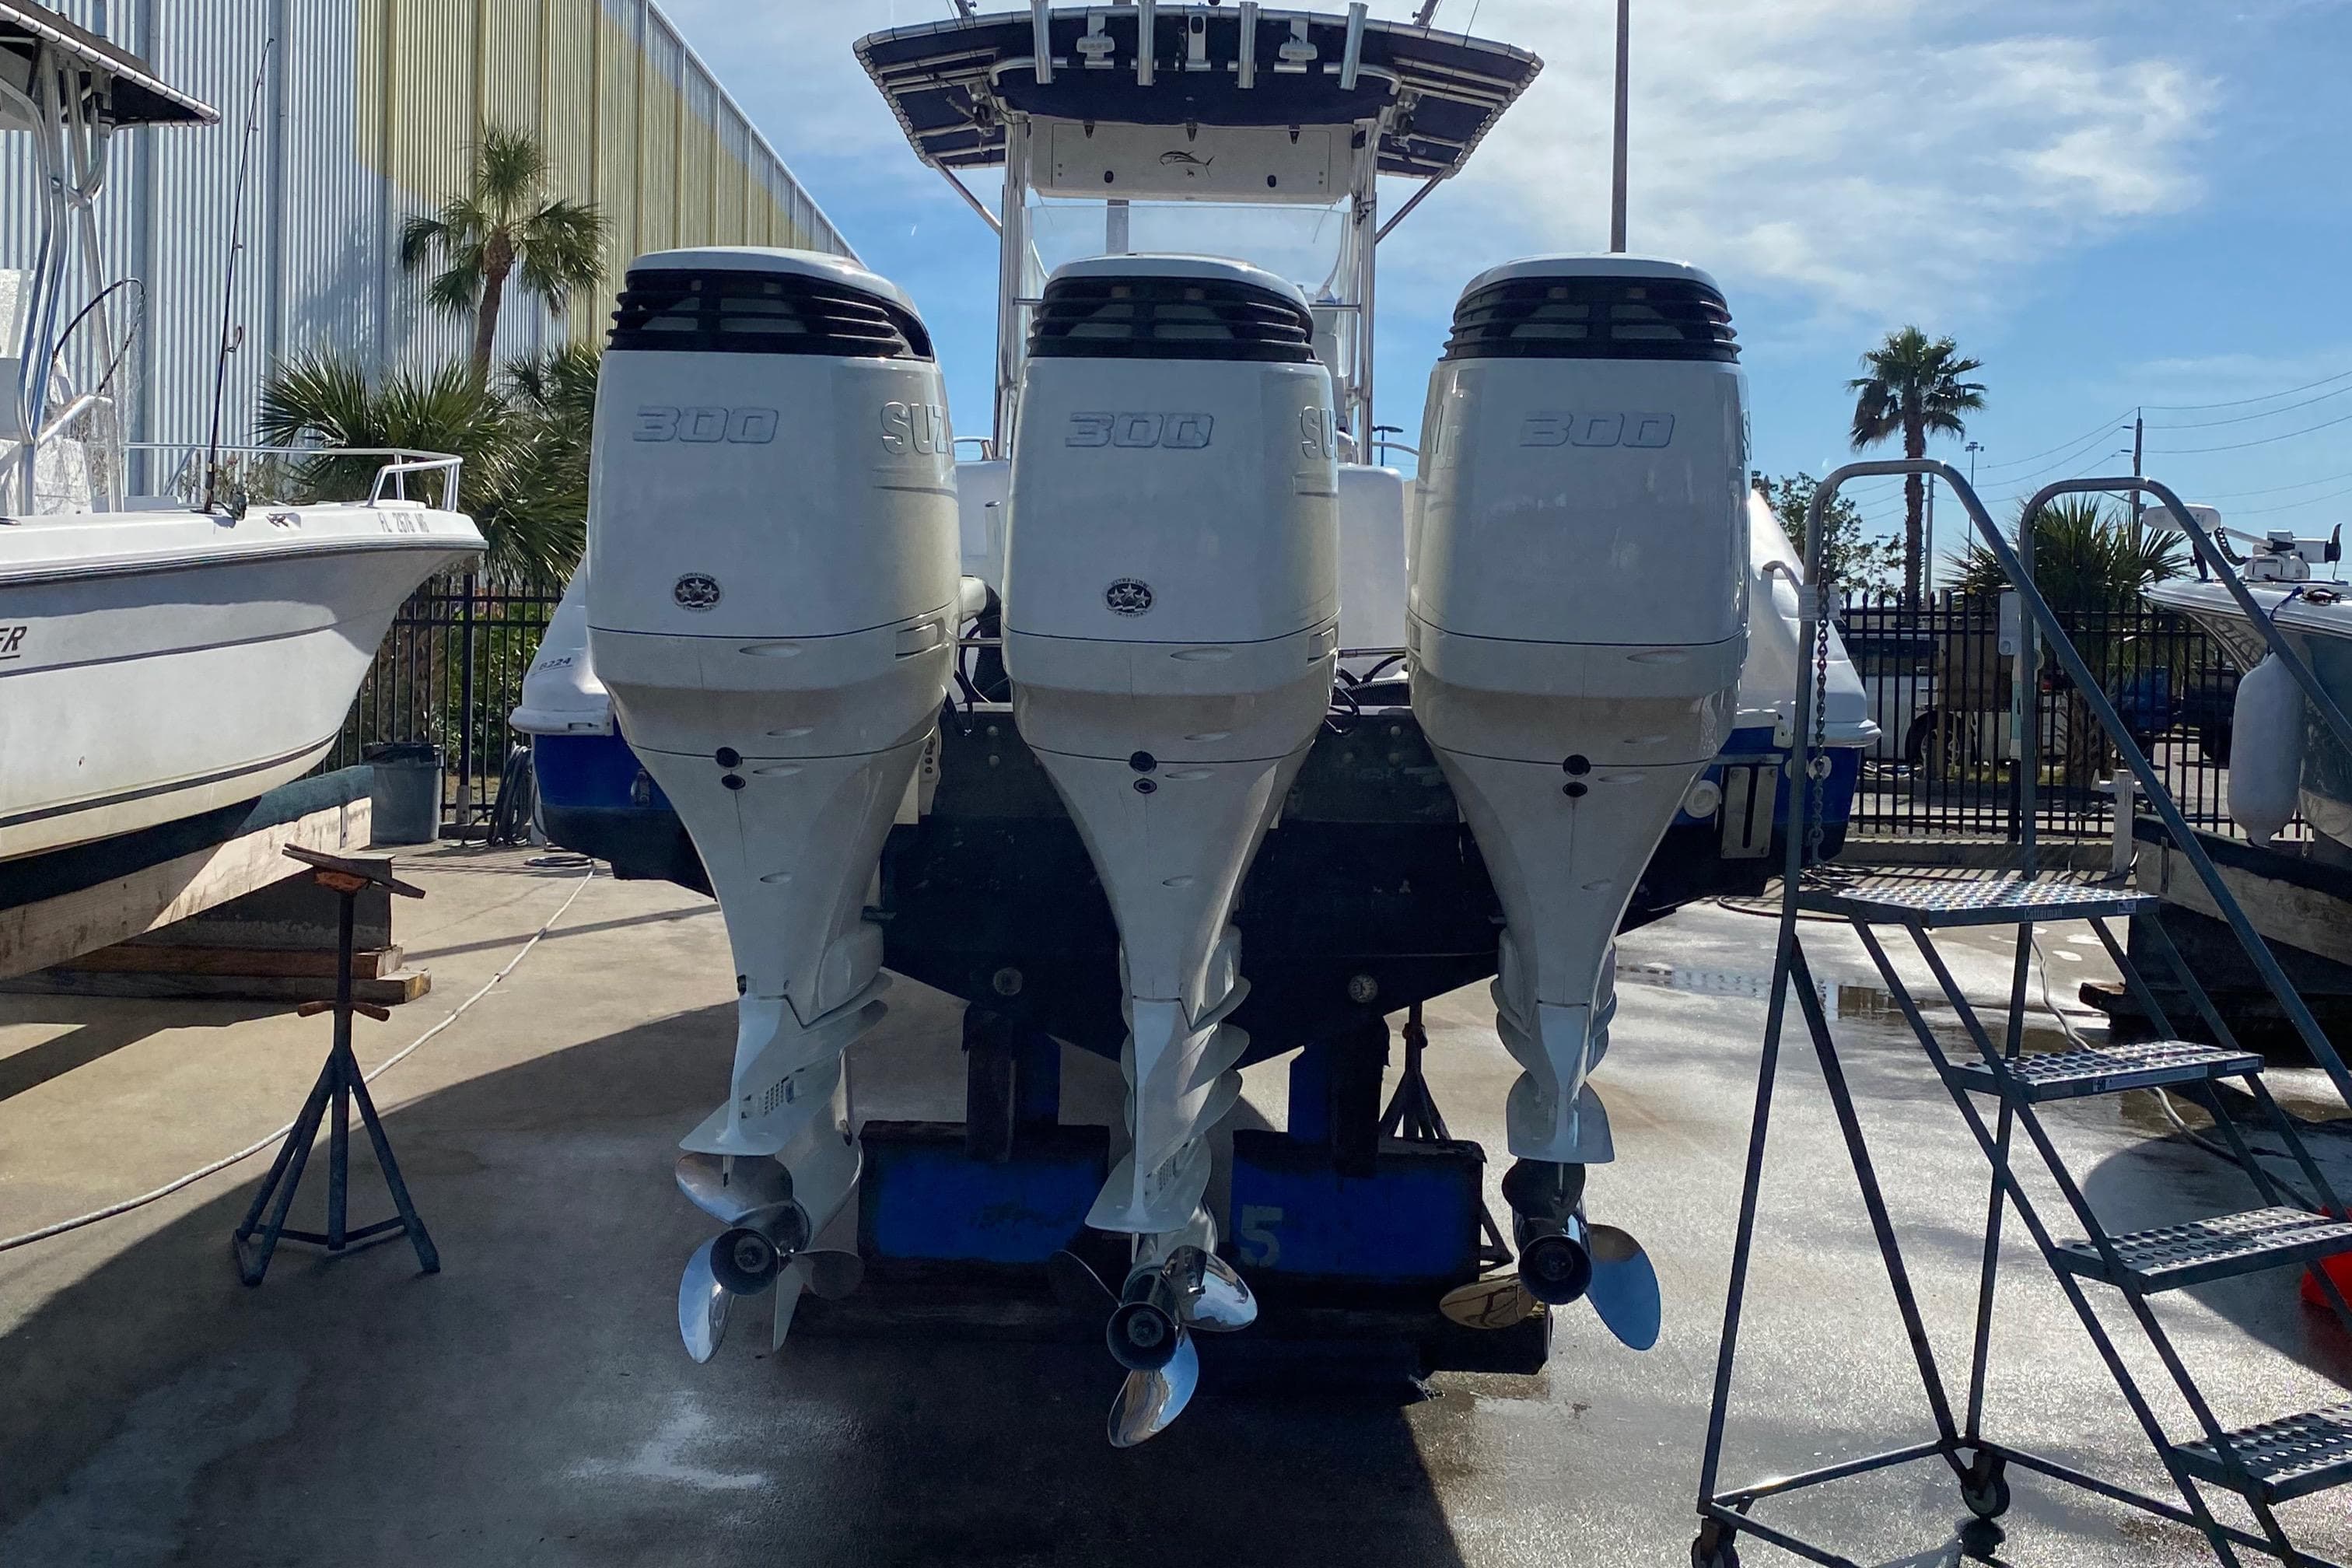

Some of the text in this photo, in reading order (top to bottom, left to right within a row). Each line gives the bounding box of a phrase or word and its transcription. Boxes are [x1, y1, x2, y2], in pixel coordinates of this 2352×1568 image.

[632, 406, 779, 444] 300
[880, 401, 951, 455] SUZ
[1065, 411, 1214, 449] 300
[1300, 405, 1338, 460] SU
[1519, 410, 1675, 448] 300
[1240, 1204, 1282, 1268] 5
